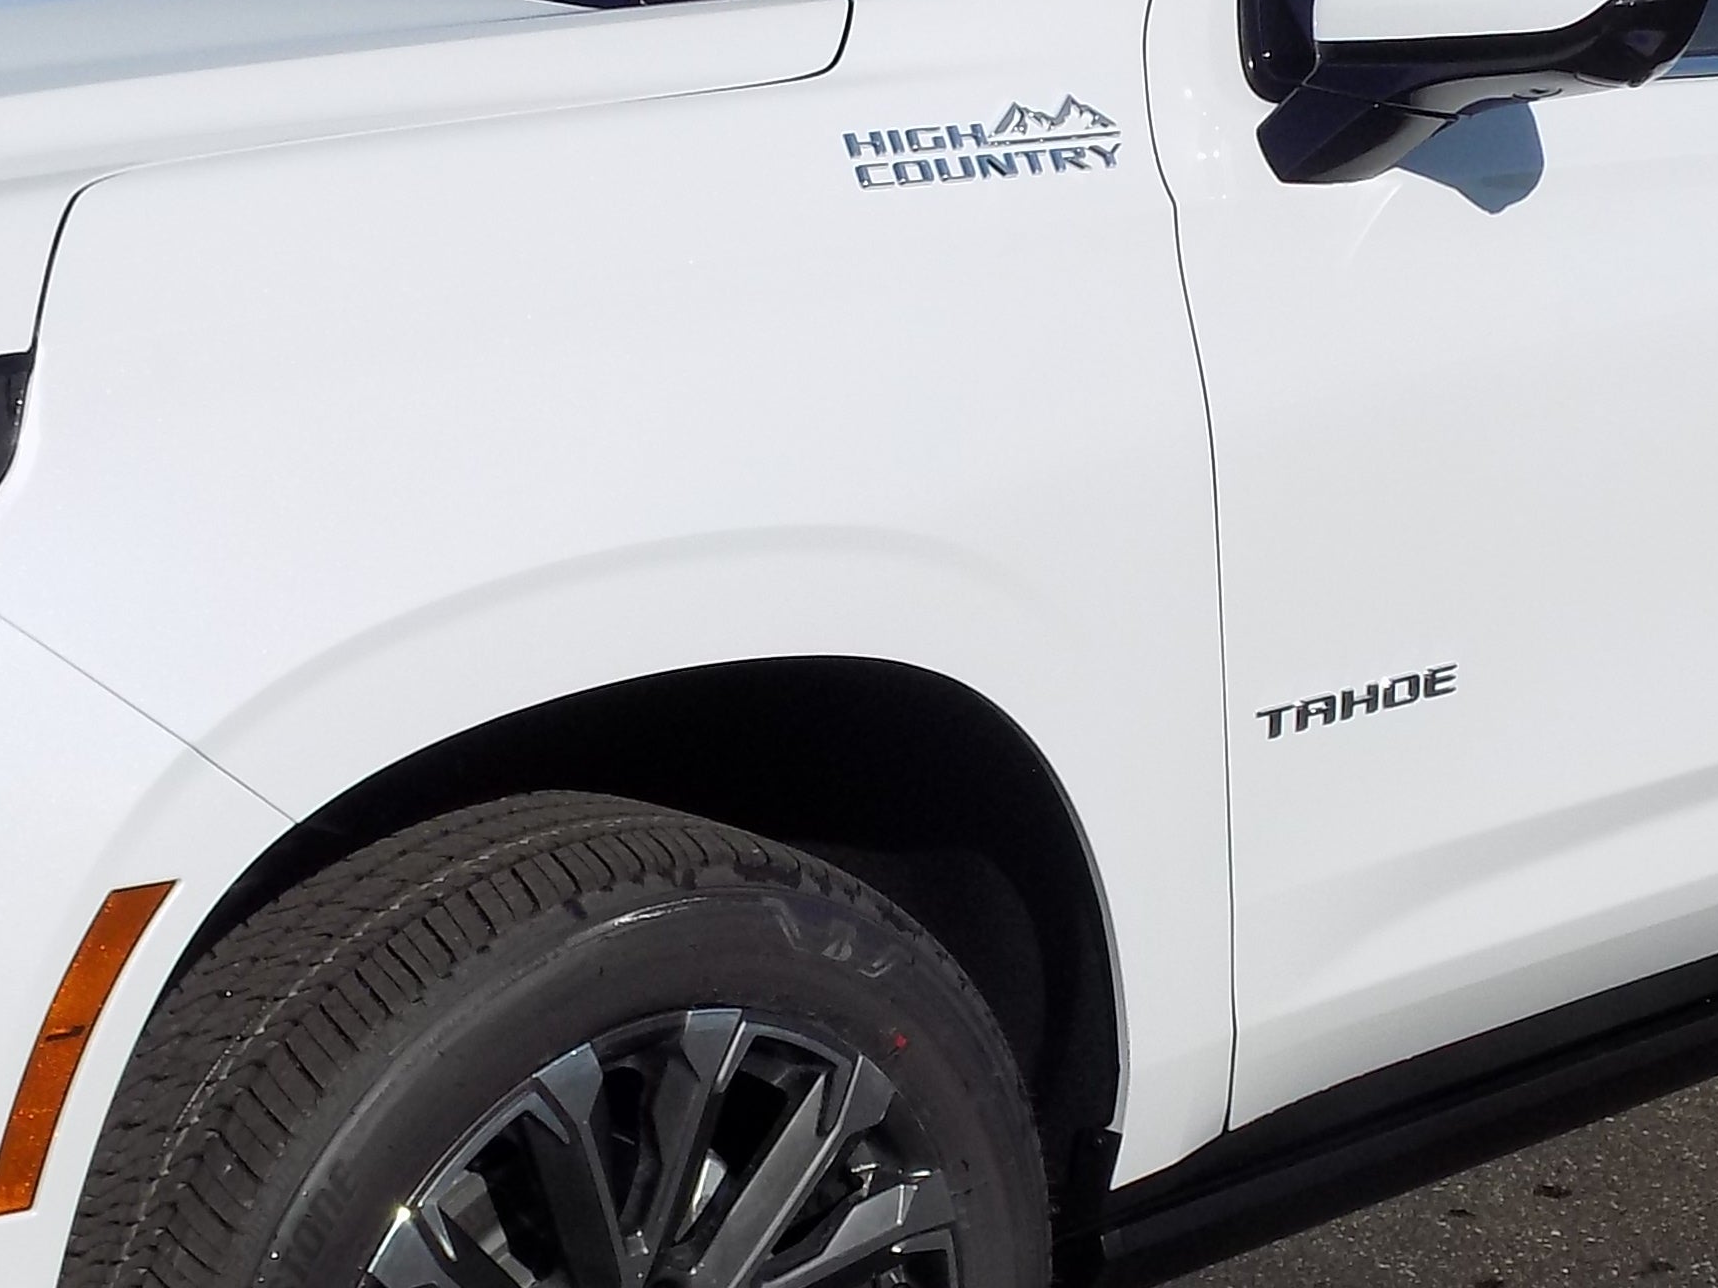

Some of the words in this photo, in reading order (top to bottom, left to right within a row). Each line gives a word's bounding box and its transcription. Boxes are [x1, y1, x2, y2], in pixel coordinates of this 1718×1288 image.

[842, 123, 988, 158] HIGH
[855, 143, 1121, 188] COUNTRY
[1255, 662, 1458, 739] TAHOE
